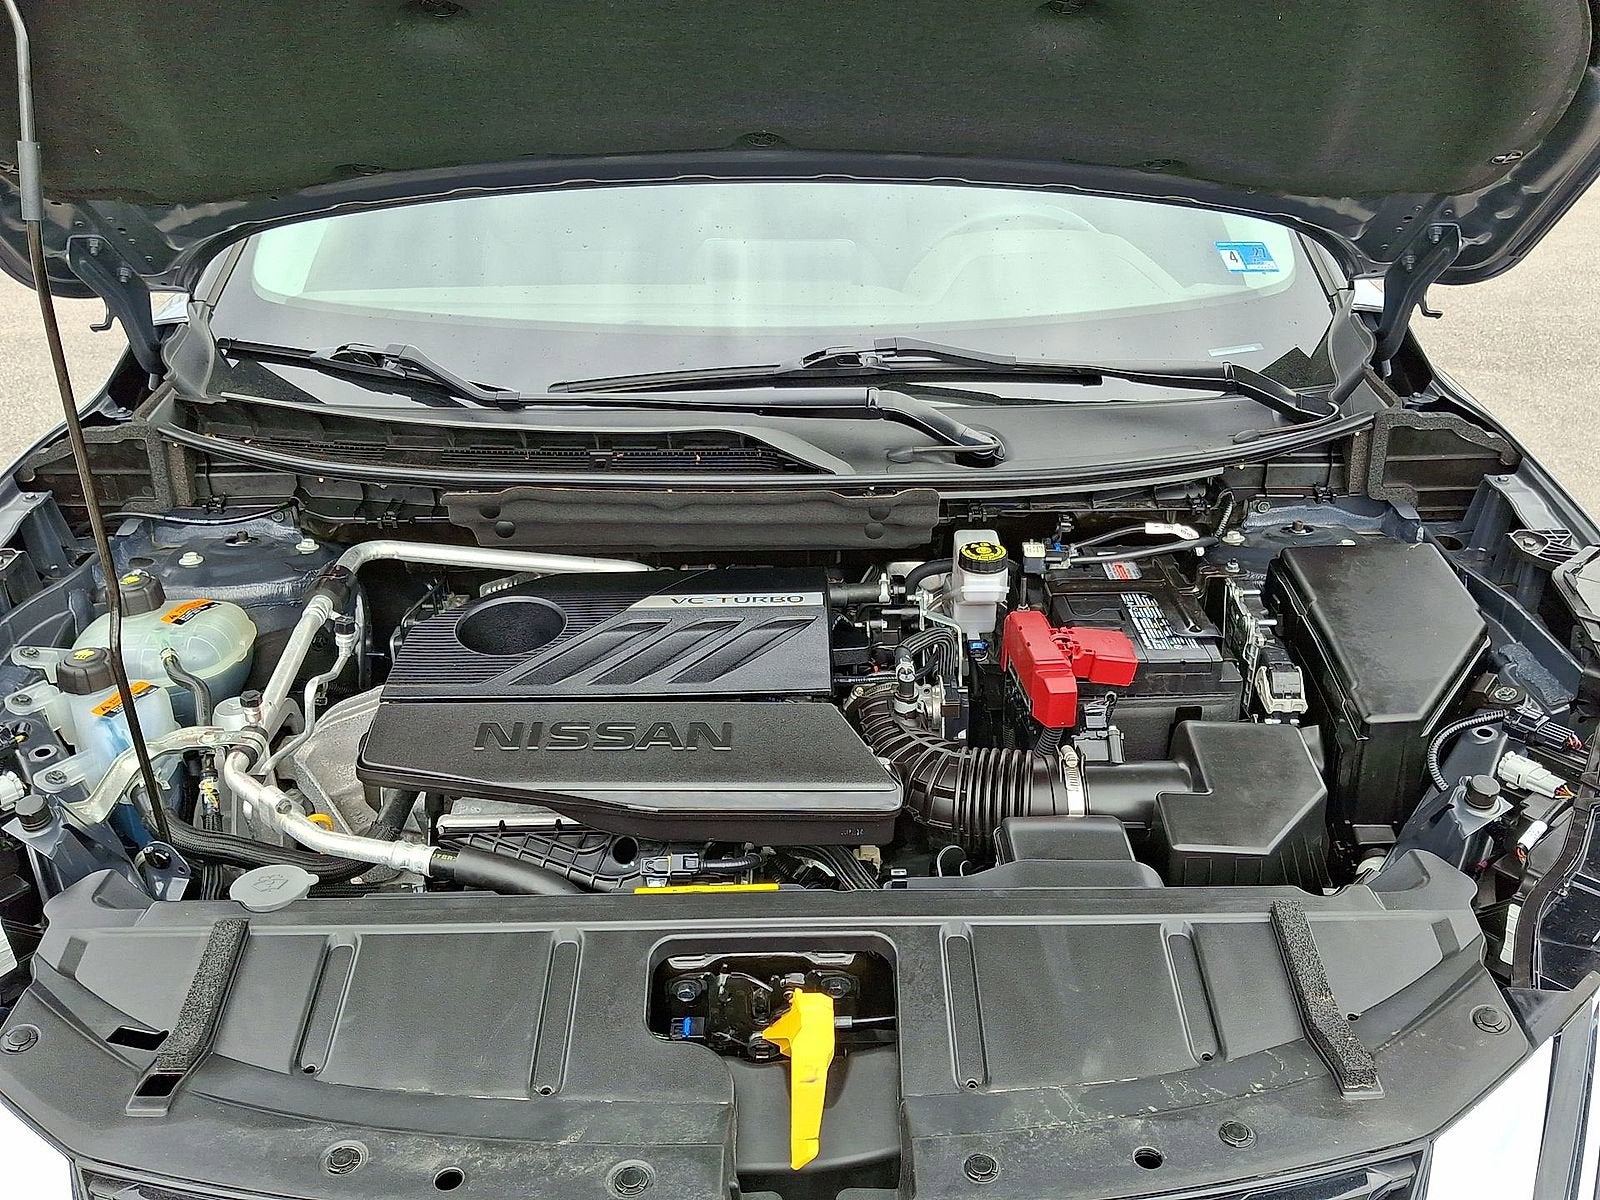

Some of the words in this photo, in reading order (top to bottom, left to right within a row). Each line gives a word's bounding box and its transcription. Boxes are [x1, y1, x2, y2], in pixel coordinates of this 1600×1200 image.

[1229, 250, 1238, 263] 4
[670, 595, 804, 605] VC-TURBO
[473, 722, 732, 750] NISSAN
